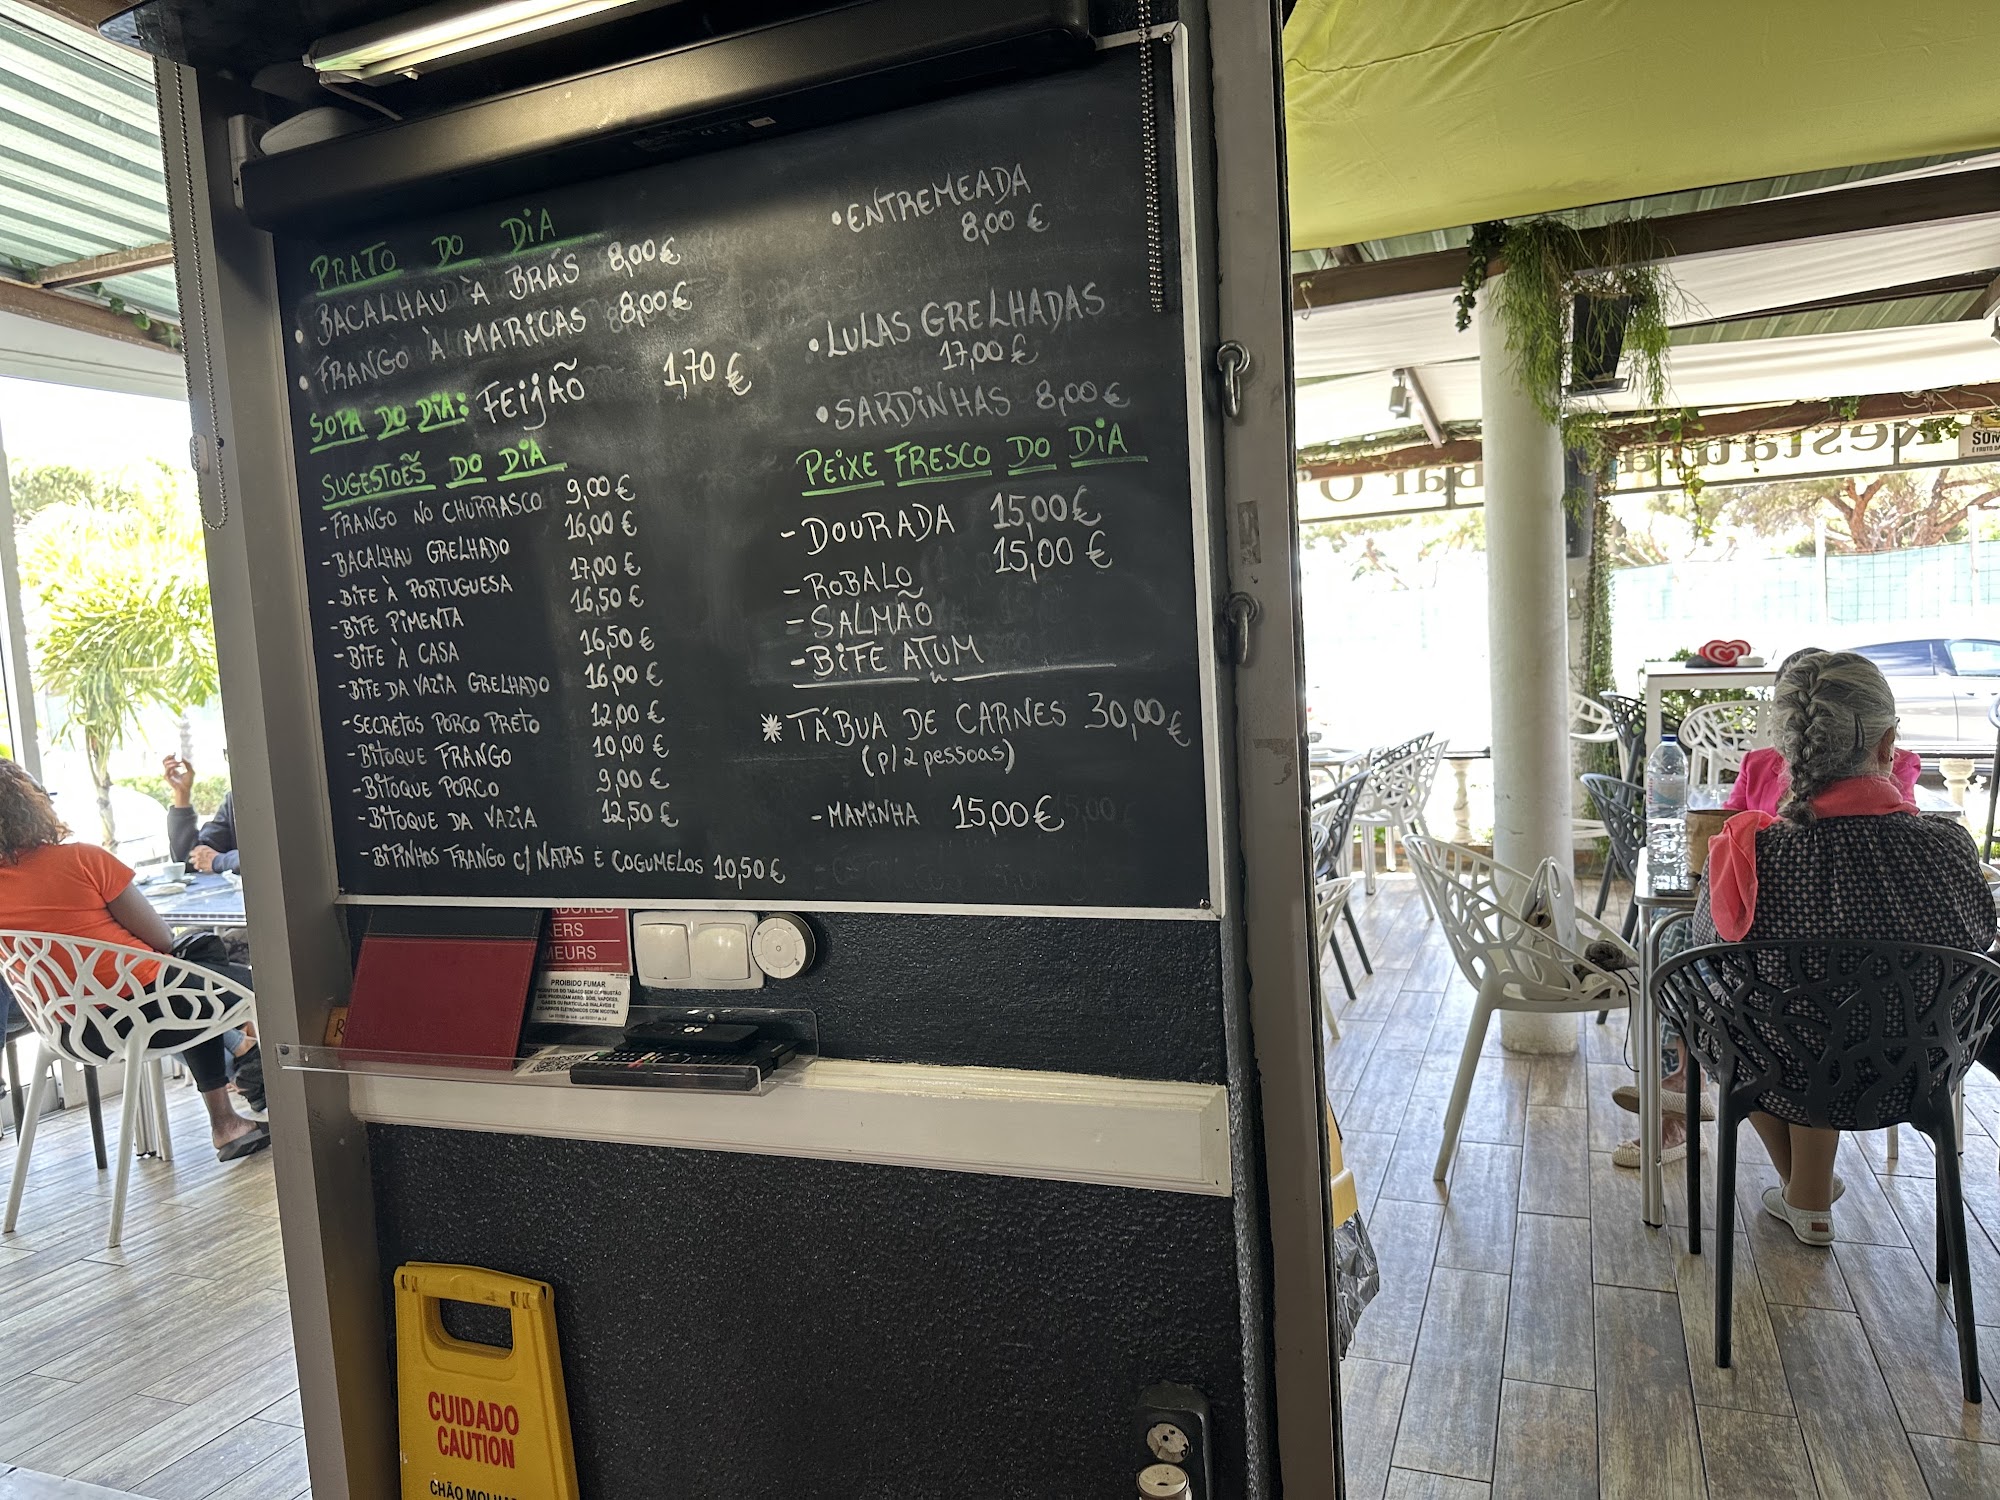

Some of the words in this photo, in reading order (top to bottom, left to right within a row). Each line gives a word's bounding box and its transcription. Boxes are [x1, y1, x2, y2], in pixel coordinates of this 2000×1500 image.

[847, 163, 1031, 233] ENTREMEADA
[310, 241, 396, 289] PRATO
[432, 235, 464, 269] DO
[316, 289, 447, 346] BACALHAU
[827, 311, 911, 358] LULAS
[920, 281, 1105, 338] GRELHADAS
[316, 349, 409, 394] FRANGO
[309, 404, 364, 444] SOPA
[376, 405, 408, 437] DO
[449, 453, 483, 482] DO
[884, 441, 991, 482] FRESCO
[1006, 435, 1051, 469] DO
[413, 500, 433, 525] NO
[442, 492, 542, 524] CHURRASCO
[426, 535, 510, 565] GRELHADO
[405, 574, 514, 599] PORTUGUESA
[418, 641, 460, 665] CASA
[902, 634, 986, 674] ATUM
[385, 679, 410, 701] DA
[468, 671, 550, 698] GRELHADO
[431, 712, 480, 734] PORCO
[903, 708, 938, 741] DE
[955, 696, 1068, 737] CARNES
[434, 742, 512, 770] FRANGO
[438, 776, 500, 798] PORCO
[448, 812, 473, 831] DA
[443, 842, 506, 870] FRANGO
[537, 840, 585, 870] NATAS
[611, 848, 704, 874] COGUMELOS
[428, 1391, 519, 1436] CUIDADO
[437, 1426, 515, 1469] CAUTION
